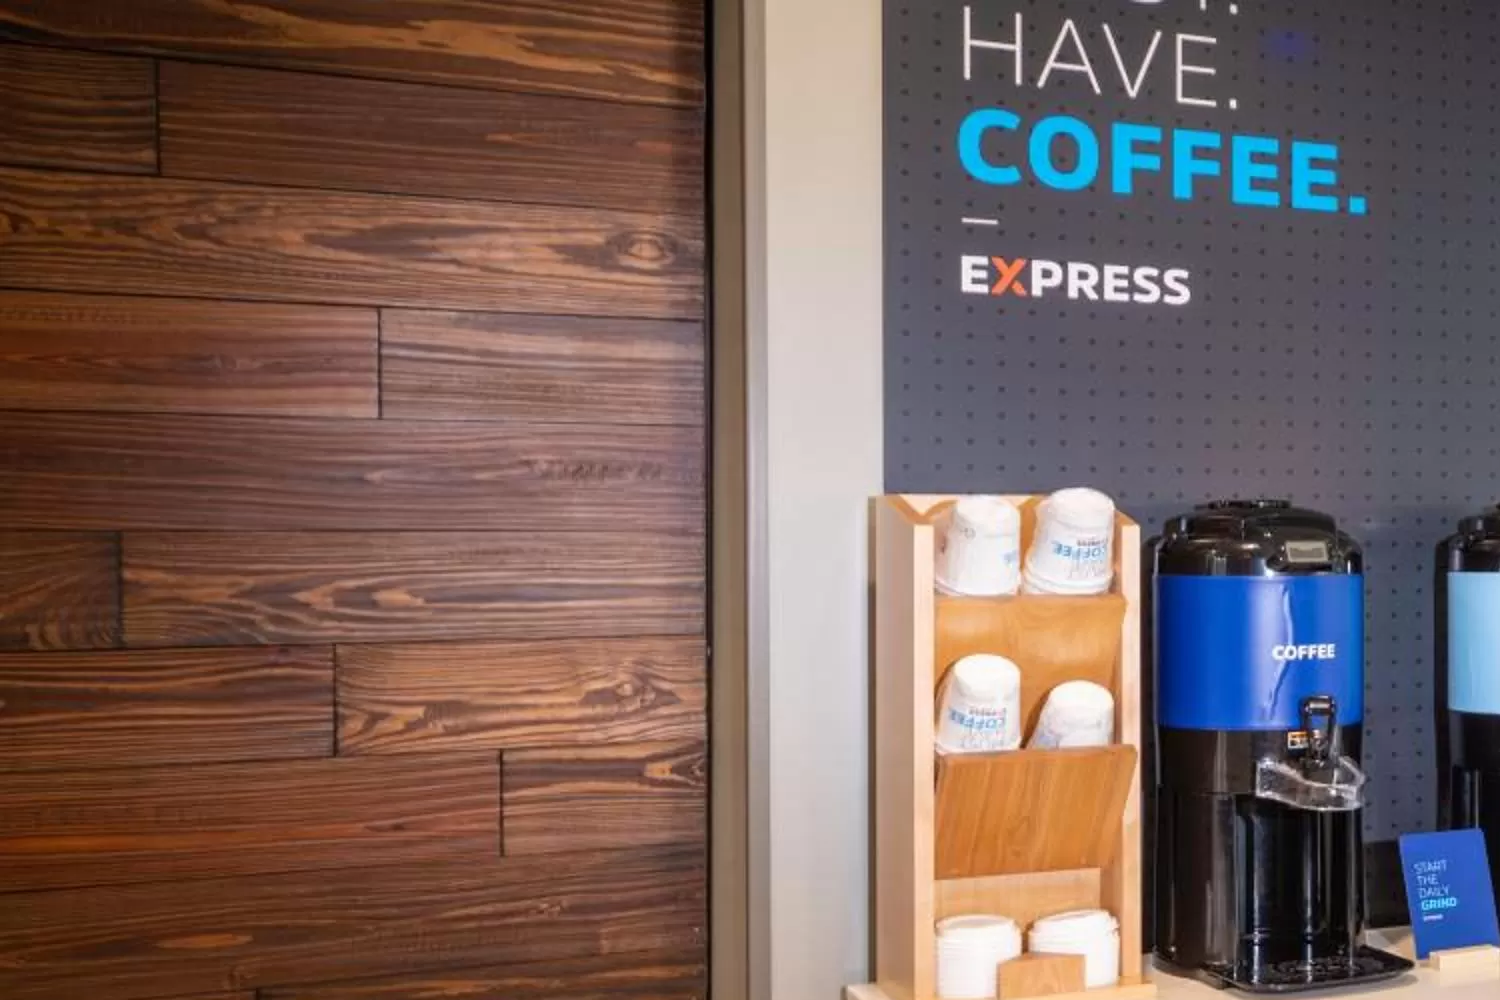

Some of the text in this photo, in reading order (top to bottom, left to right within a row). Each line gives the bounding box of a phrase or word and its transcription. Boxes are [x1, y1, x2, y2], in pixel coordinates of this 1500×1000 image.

[963, 6, 1238, 109] HAVE.
[956, 108, 1367, 214] COFFEE.
[960, 255, 1191, 305] EXPRESS
[1271, 643, 1336, 660] COFFEE
[1413, 859, 1448, 875] START
[1416, 873, 1439, 886] THE
[1418, 883, 1450, 899] DAILY
[1420, 896, 1457, 911] GRIND
